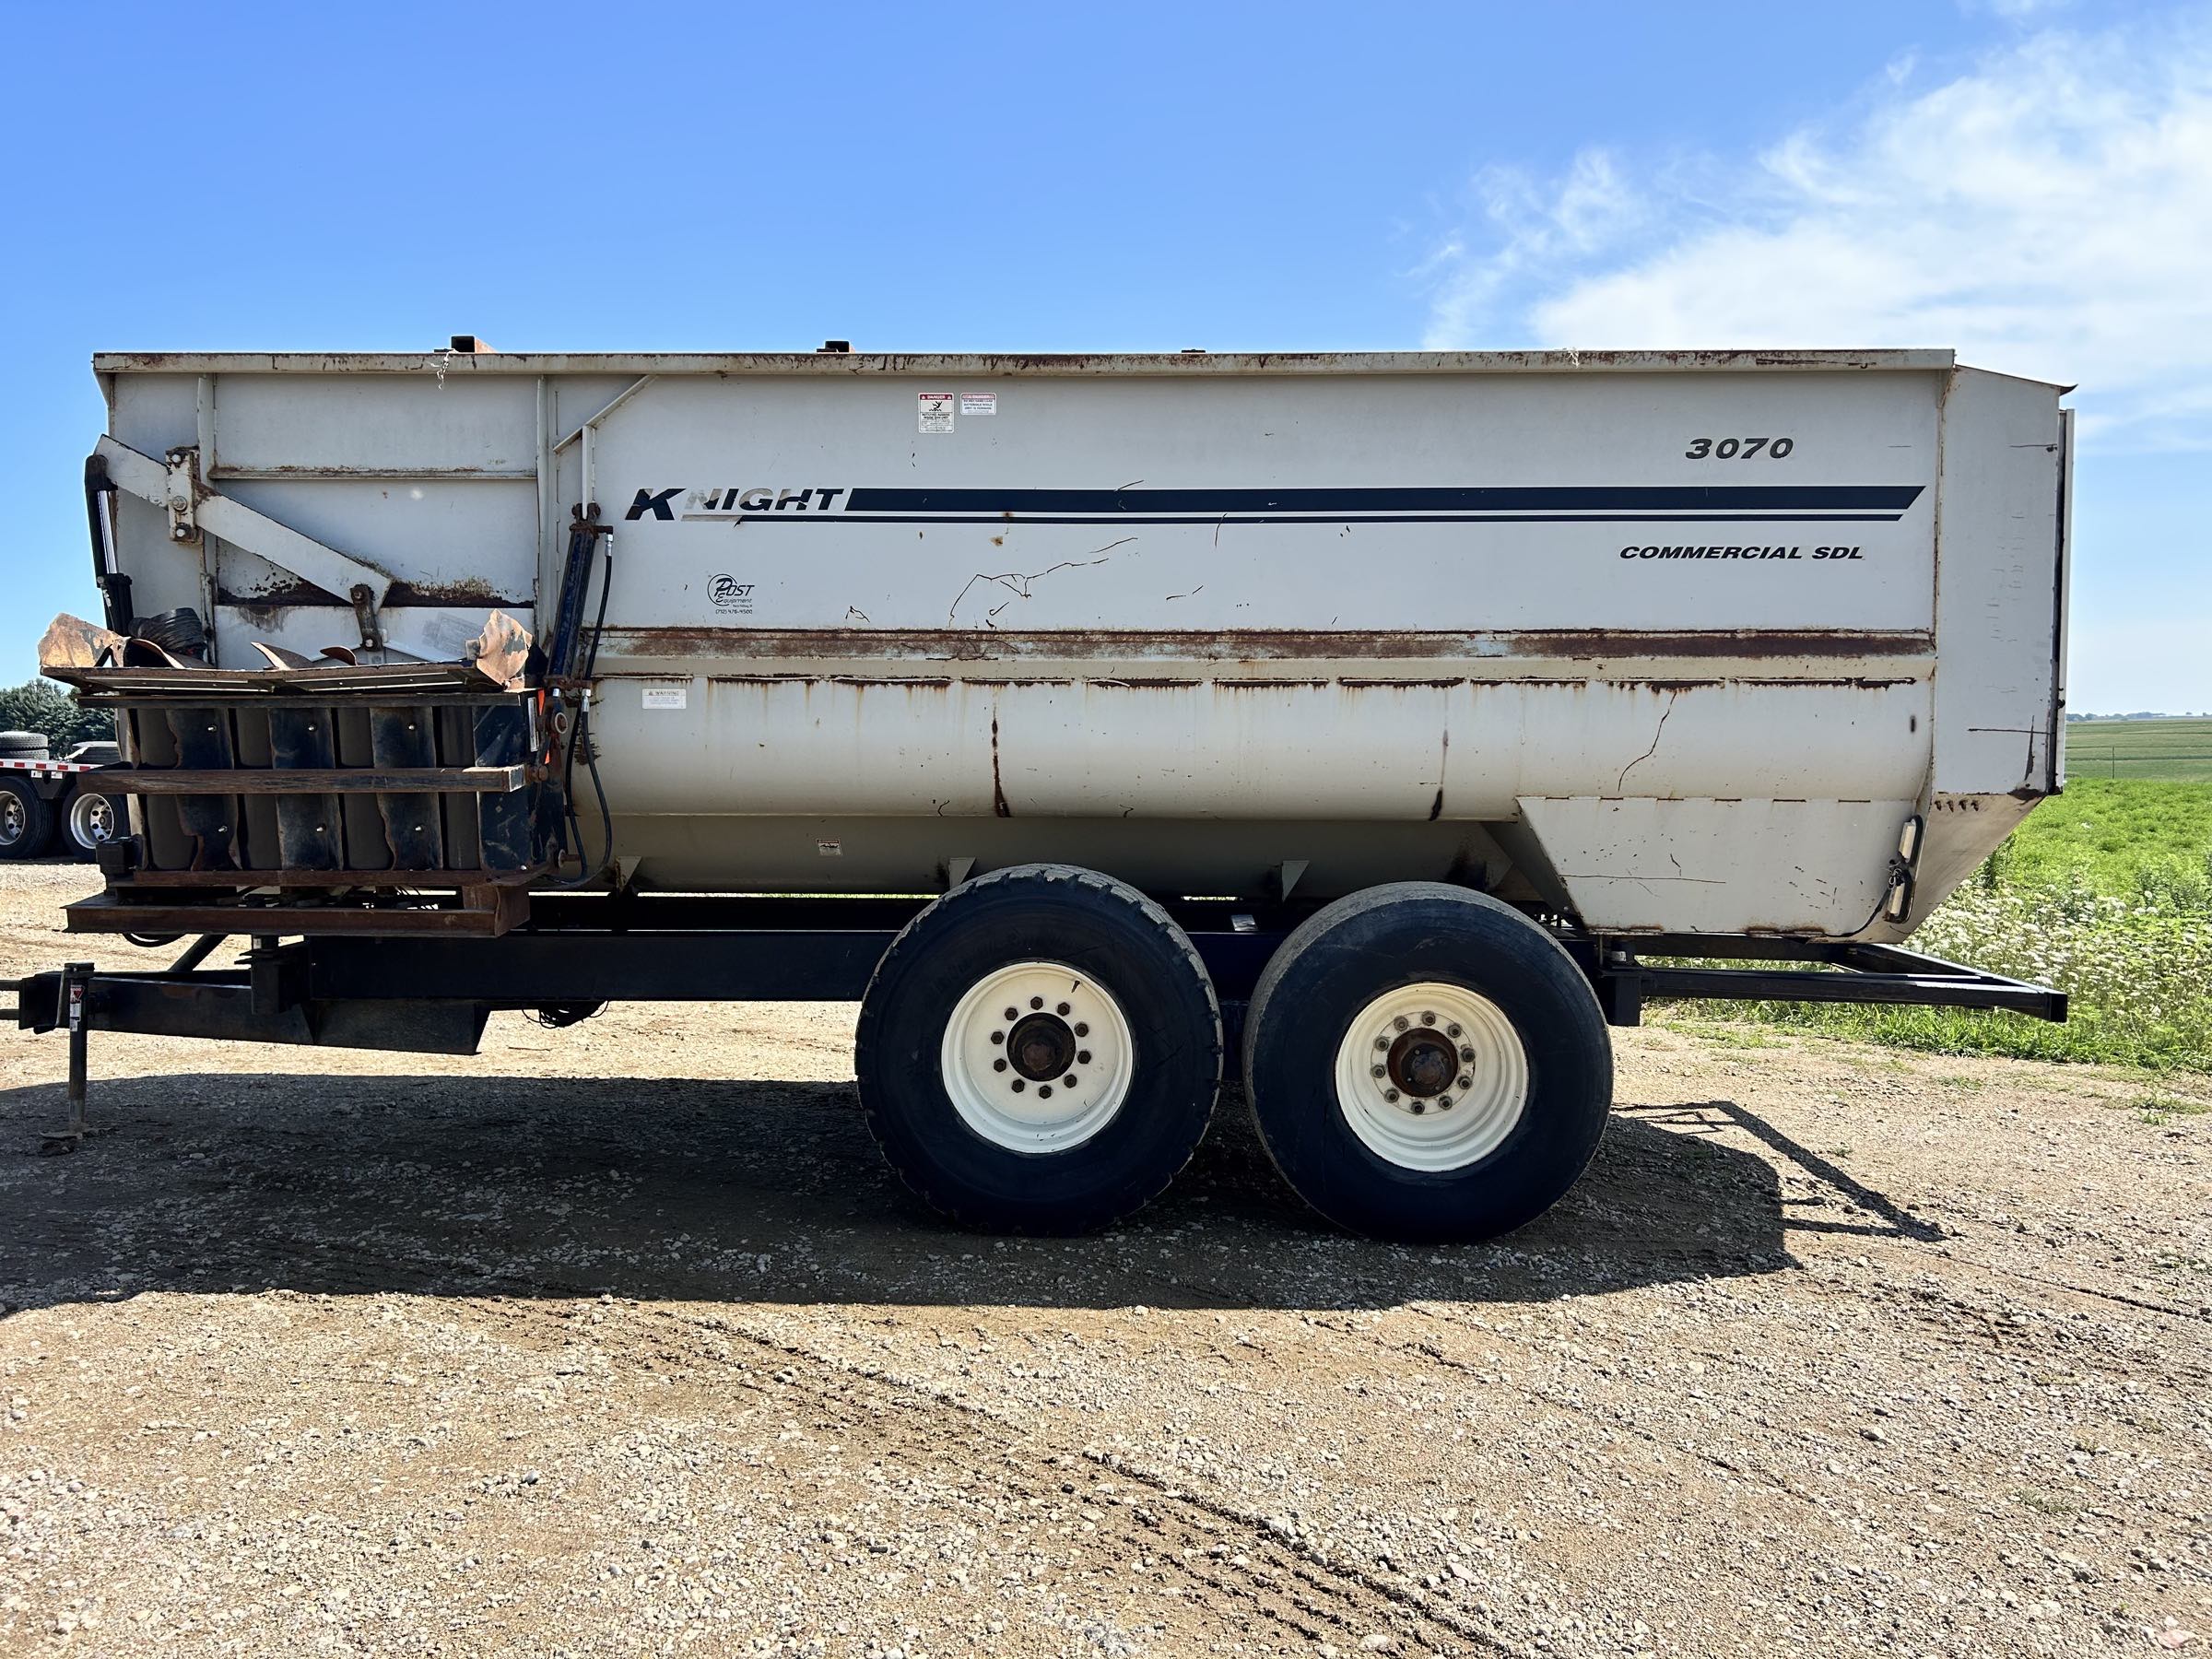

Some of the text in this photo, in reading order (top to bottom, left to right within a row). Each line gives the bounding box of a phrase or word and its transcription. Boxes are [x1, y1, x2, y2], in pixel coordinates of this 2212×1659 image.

[1685, 438, 1794, 459] 3070
[625, 488, 844, 520] KNIGHT
[1619, 546, 1864, 559] COMMERCIAL SDL
